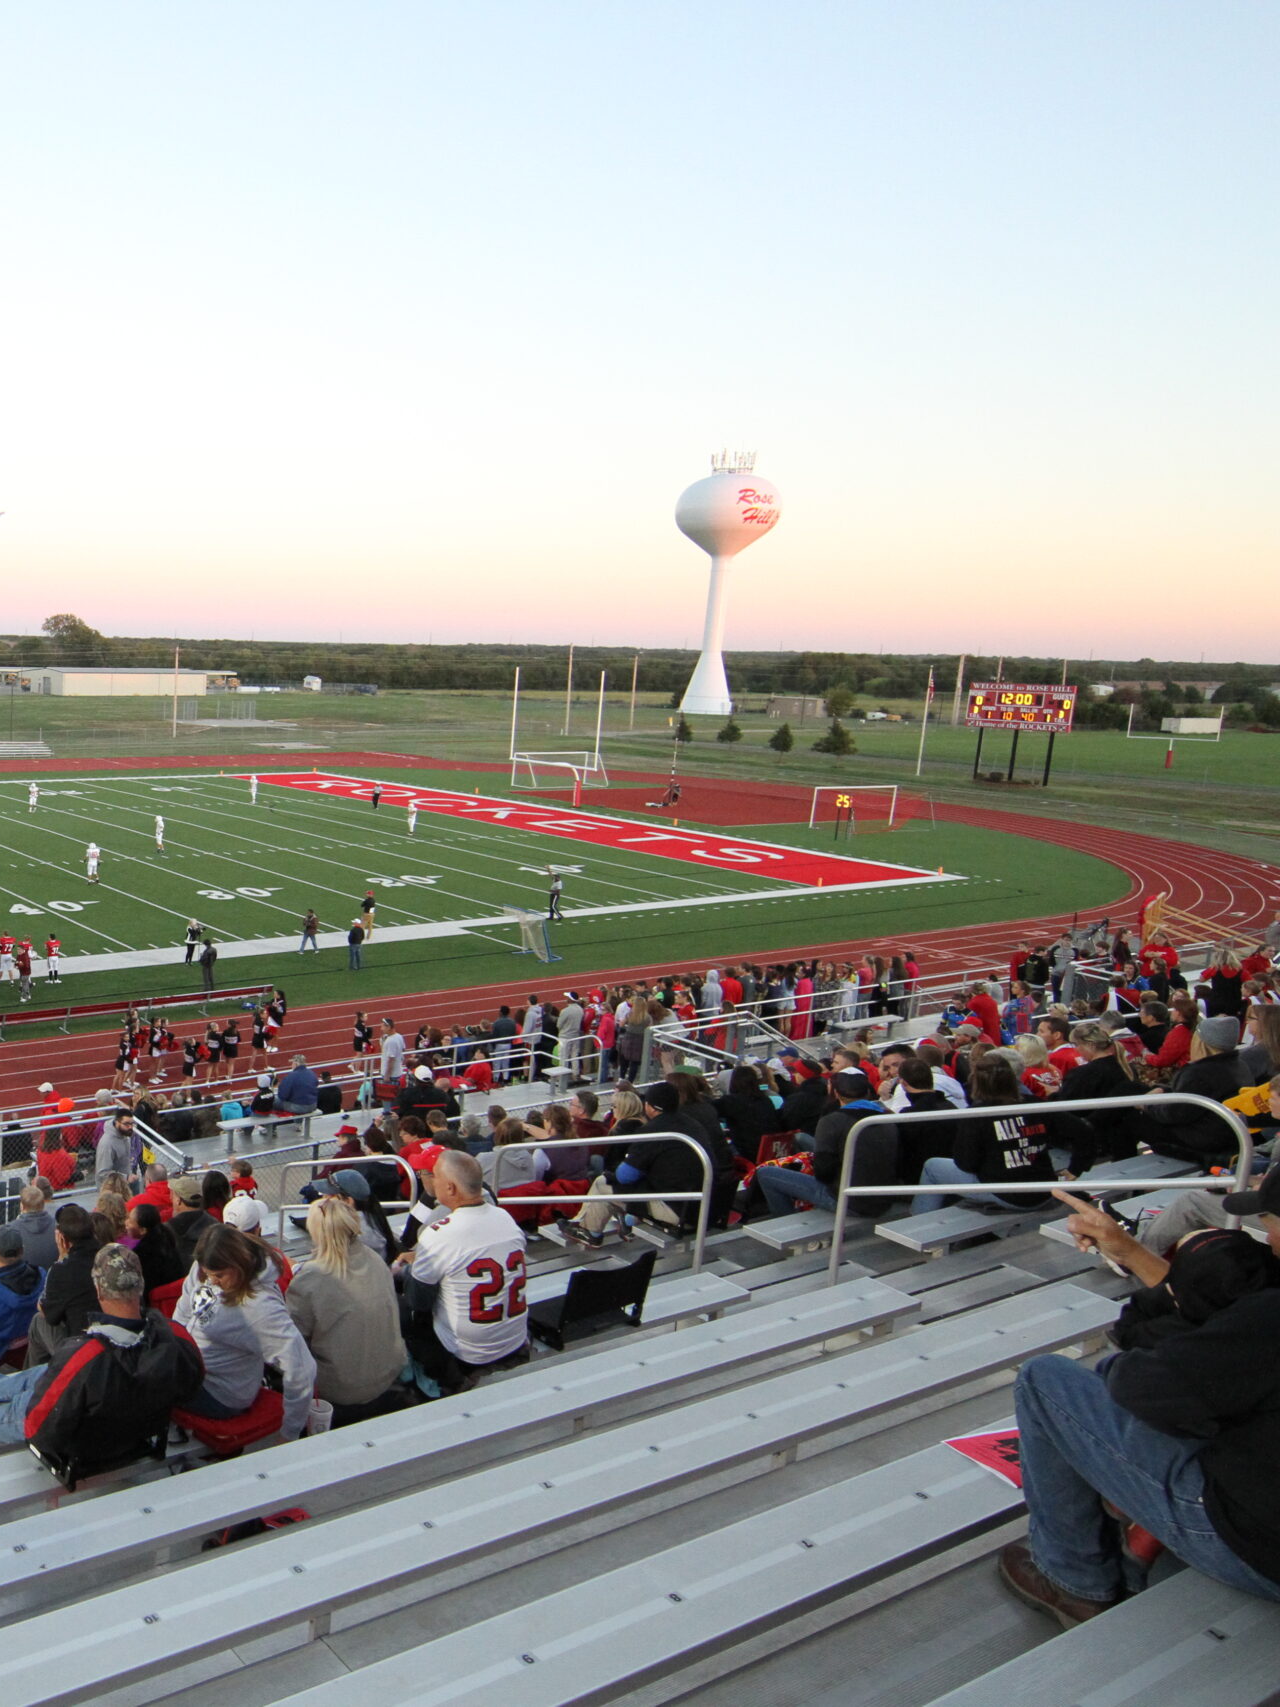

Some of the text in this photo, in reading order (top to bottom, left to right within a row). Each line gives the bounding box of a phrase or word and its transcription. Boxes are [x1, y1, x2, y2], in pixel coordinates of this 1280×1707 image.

[736, 488, 773, 505] Rose
[742, 507, 776, 524] Hill
[973, 682, 1014, 691] WELCOME
[975, 695, 983, 705] 0
[1001, 693, 1033, 705] 12:00
[1063, 699, 1071, 709] 0
[1002, 712, 1012, 720] 10
[1021, 713, 1034, 721] 40
[1019, 723, 1057, 731] ROCKETS
[836, 794, 850, 808] 25
[304, 779, 784, 863] ROCKETS
[366, 875, 436, 887] 20
[197, 886, 271, 900] 30
[10, 900, 84, 915] 40
[993, 1118, 1021, 1141] ALL
[466, 1250, 527, 1323] 22
